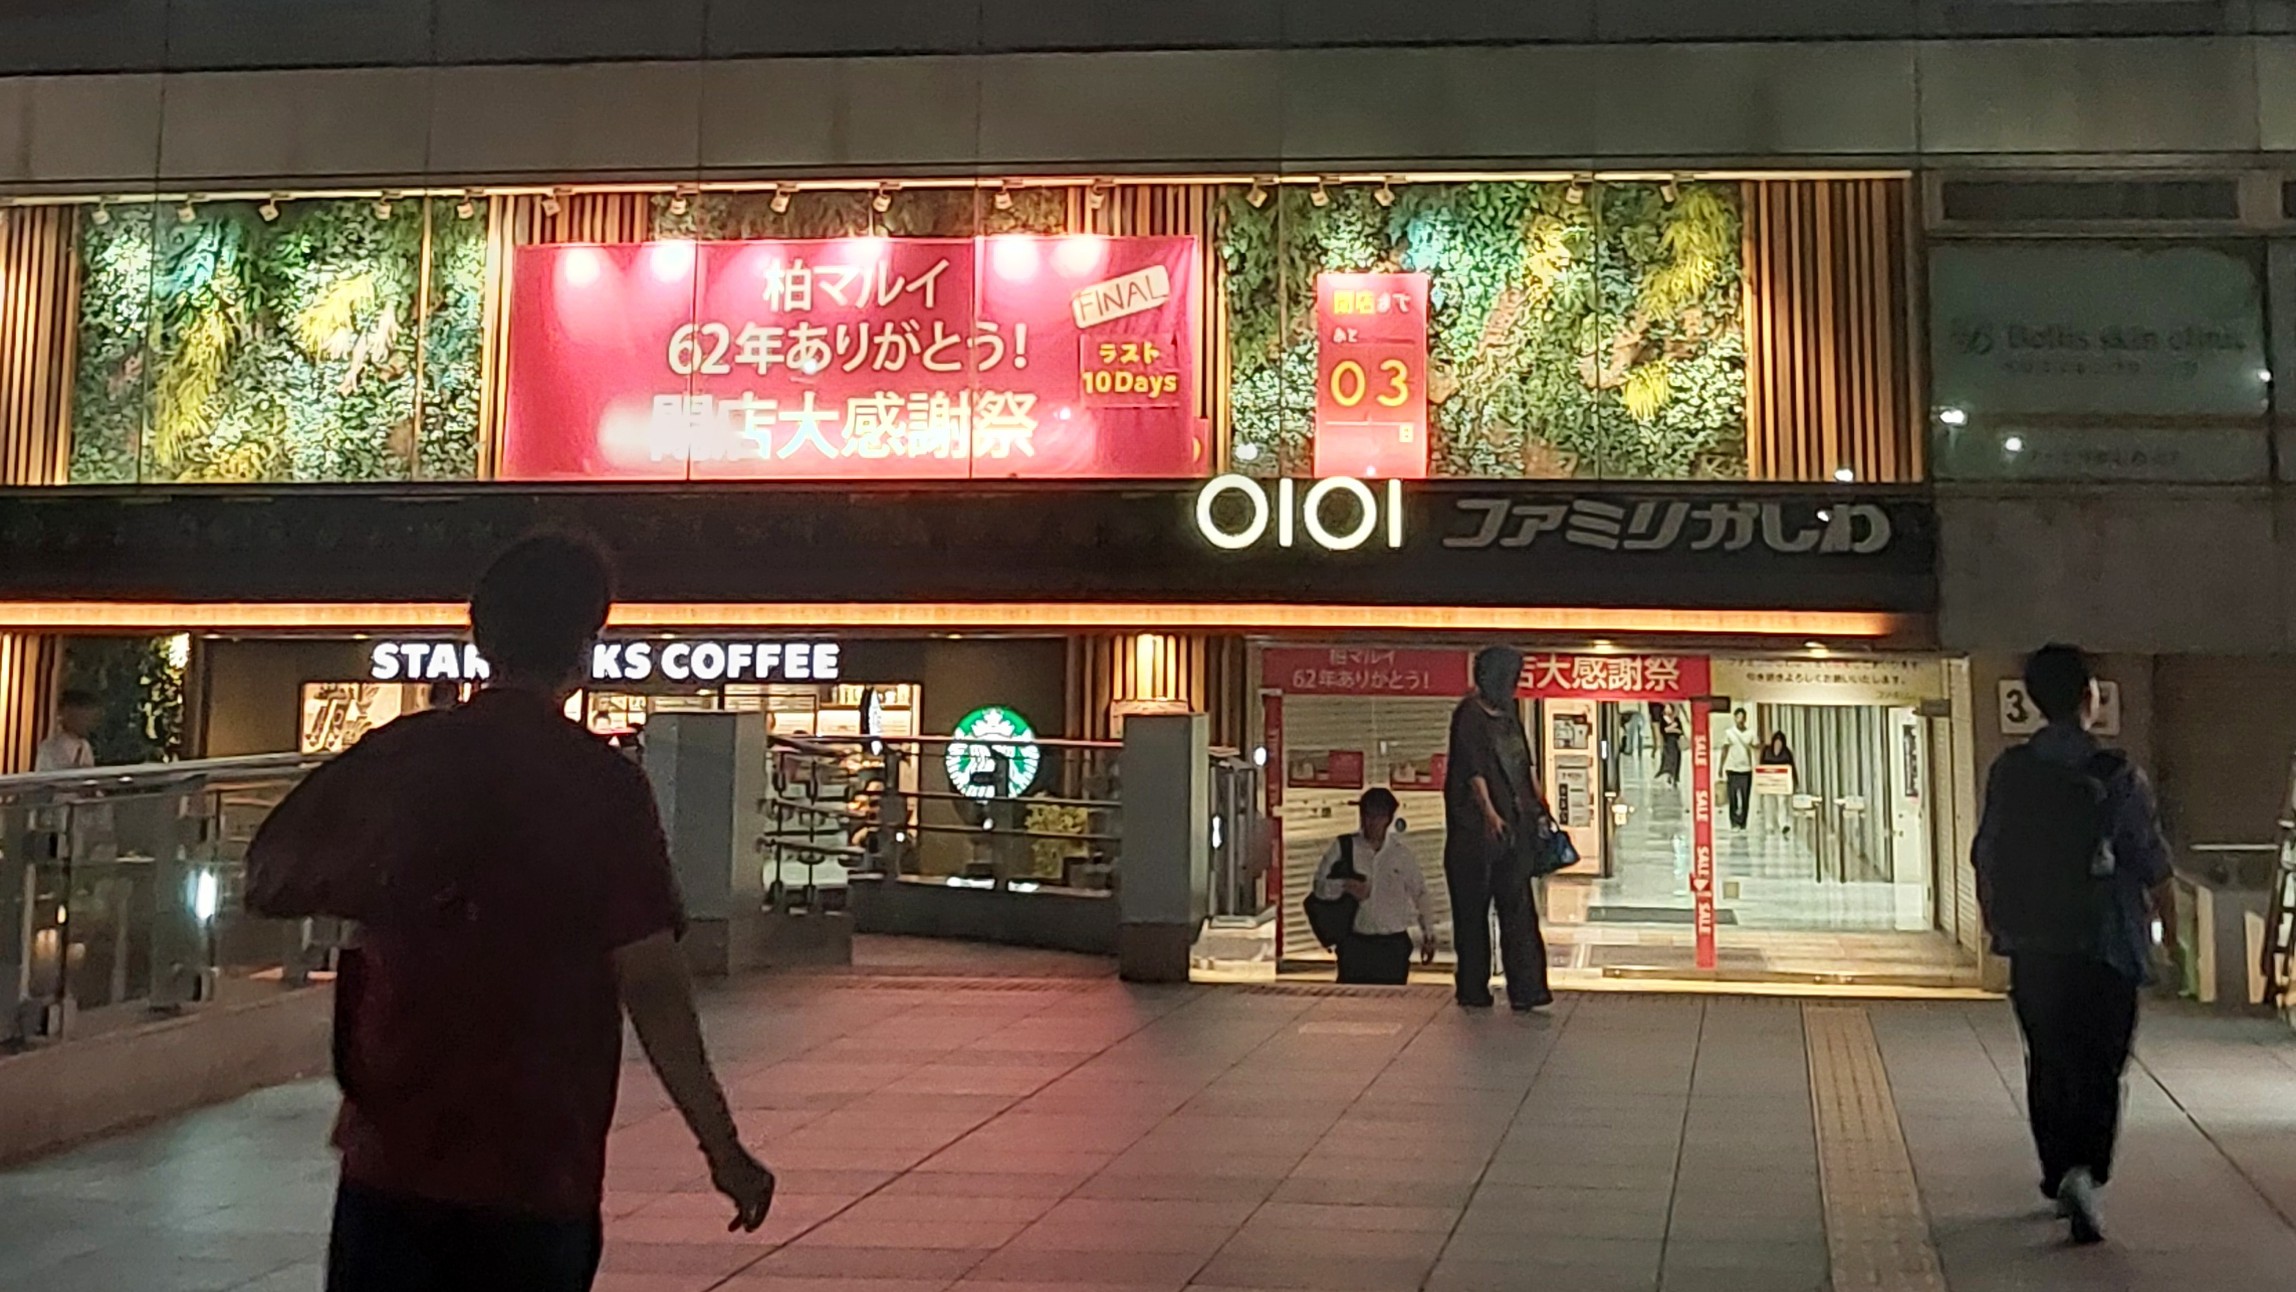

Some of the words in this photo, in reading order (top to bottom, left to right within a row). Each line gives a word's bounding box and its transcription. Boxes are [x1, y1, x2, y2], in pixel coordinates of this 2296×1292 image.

[763, 258, 950, 312] 柏マルイ
[1076, 274, 1169, 321] FINAL
[1099, 341, 1161, 365] ラスト
[661, 642, 840, 680] COFFEE
